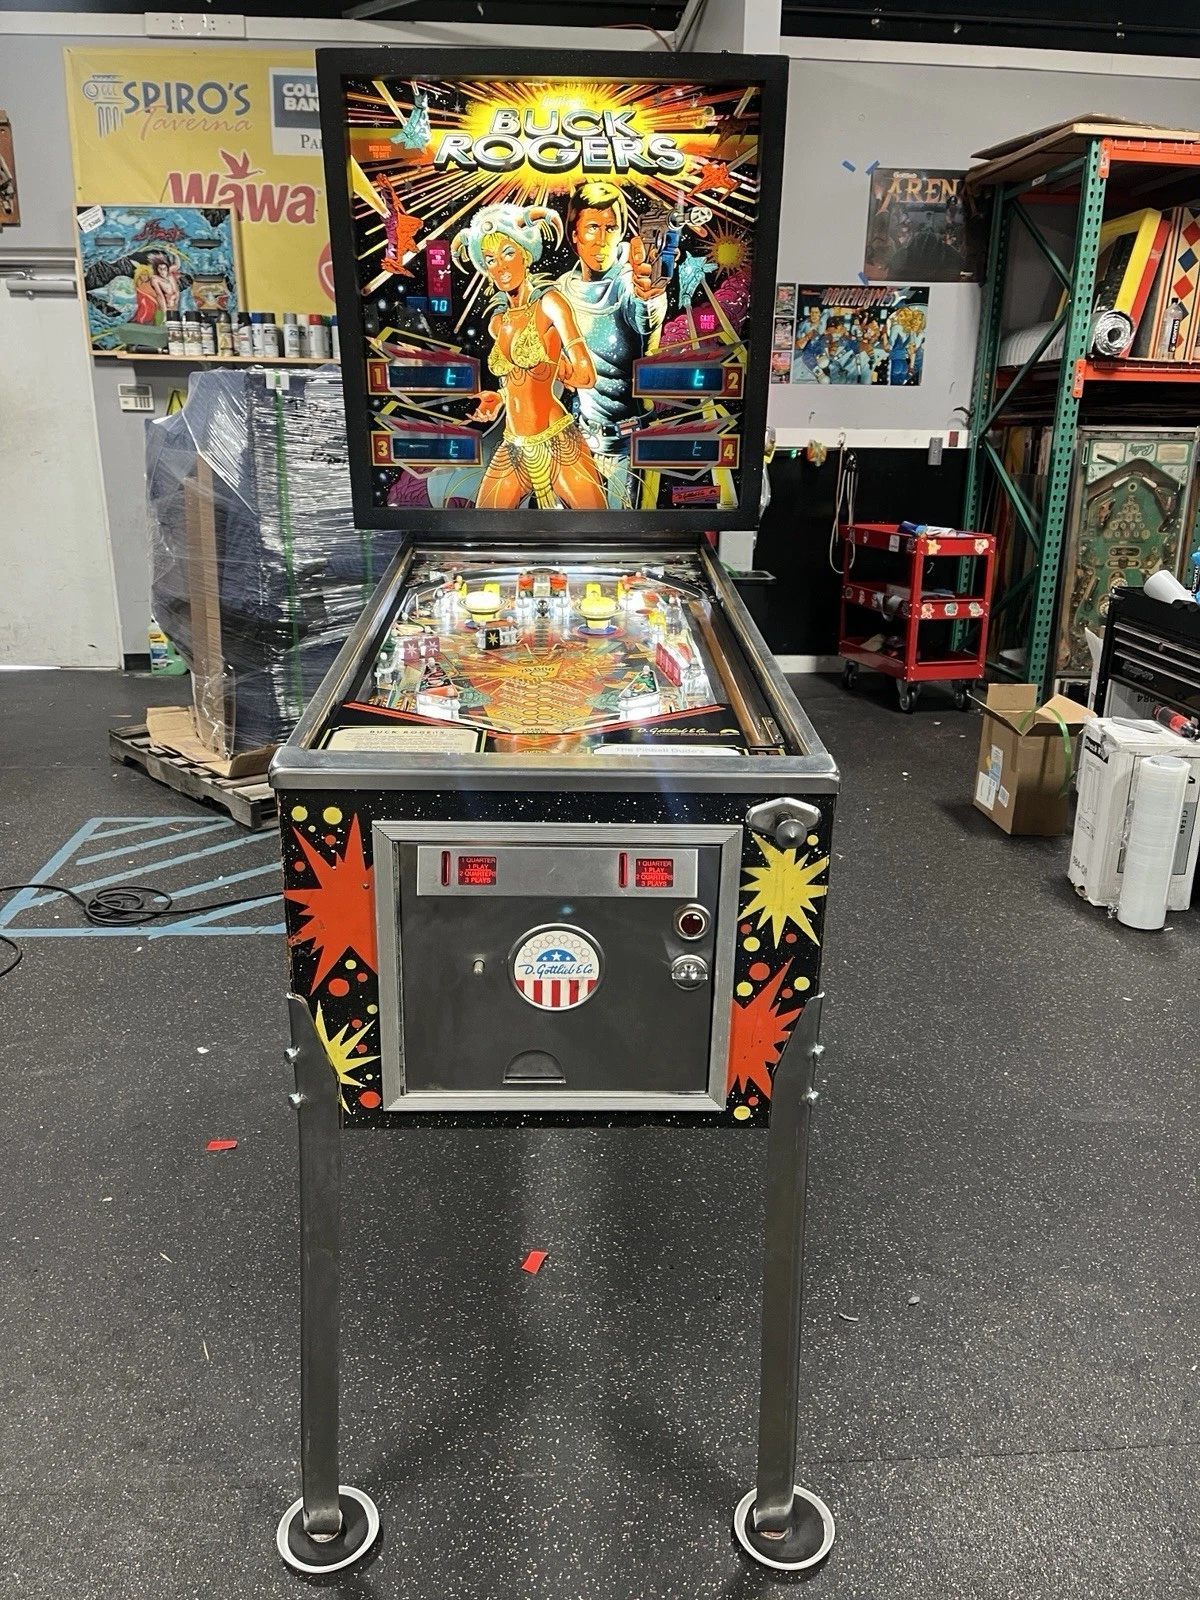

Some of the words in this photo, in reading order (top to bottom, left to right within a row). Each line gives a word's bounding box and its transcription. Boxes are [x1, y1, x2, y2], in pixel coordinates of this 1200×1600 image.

[122, 81, 251, 115] SPIRO'S
[135, 104, 252, 140] Taverna
[489, 108, 644, 143] BUCK
[433, 132, 688, 176] ROGERS
[168, 172, 316, 224] Wawa
[374, 367, 382, 385] 1
[728, 372, 740, 390] 2
[377, 440, 388, 457] 3
[723, 443, 735, 460] 4
[518, 963, 535, 975] D.
[536, 963, 576, 980] Gottlieb
[583, 963, 595, 974] Co.
